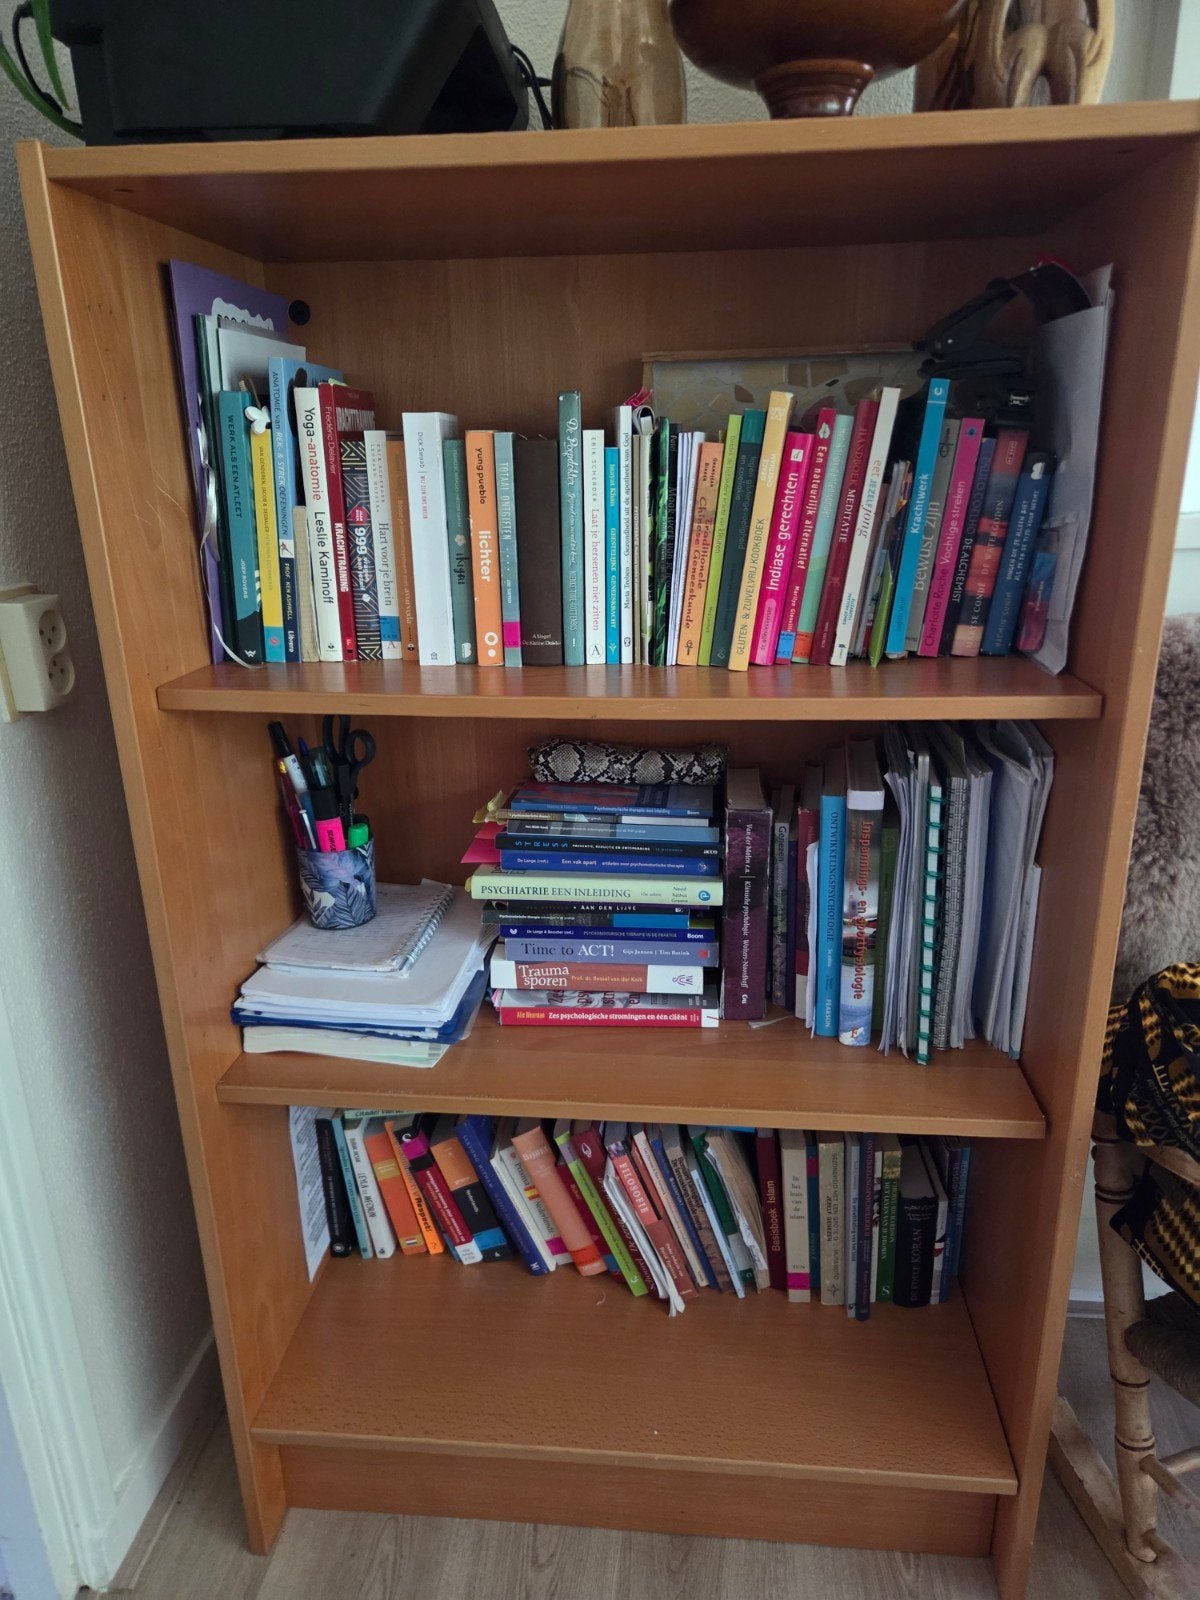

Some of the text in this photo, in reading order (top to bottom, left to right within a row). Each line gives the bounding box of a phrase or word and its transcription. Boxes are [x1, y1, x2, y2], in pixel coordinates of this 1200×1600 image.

[272, 372, 281, 413] ANATOMIE
[276, 431, 285, 450] REK-
[417, 432, 426, 469] Dick Swaab
[562, 418, 578, 486] De Poepdokter
[227, 415, 242, 519] WERK ALS EEN ATLEET
[608, 463, 616, 485] Inayat
[623, 463, 631, 495] apotheek
[838, 427, 867, 543] HANDBOEK MEDITATIE
[277, 461, 289, 535] STREKOEFENINGEN
[304, 407, 334, 604] Yoga-anatomie Leslie Kaminoff
[325, 406, 349, 592] Frédéric Delavier KRACHTTRAINING
[475, 447, 493, 582] yung pueblo lichter
[499, 462, 511, 540] TOTAAL ONTGIFTEN
[623, 496, 630, 505] de
[668, 487, 678, 514] Maak
[797, 445, 828, 570] Een natuurlijk alternatief
[857, 459, 882, 539] eet JEZELF jong
[909, 473, 930, 534] Krachtwerk
[589, 530, 600, 539] je
[591, 508, 600, 528] Laat
[667, 516, 676, 540] werk
[765, 473, 798, 591] Indiase gerechten
[984, 500, 1004, 561] WATERGODIN
[354, 527, 367, 555] 999
[697, 516, 714, 589] Traditionele
[714, 528, 726, 554] kleuren
[914, 501, 940, 590] Bewust zijn
[962, 538, 974, 550] DE
[356, 571, 366, 591] jezelf
[378, 522, 393, 608] Hart voor brein
[453, 553, 470, 585] ikigai
[591, 541, 600, 584] hersenen
[684, 496, 707, 629] Chinese Geneeskunde
[923, 480, 966, 647] Charlotte Roche Vochtige streken
[952, 551, 972, 603] ALCHEMIST
[592, 586, 600, 603] niet
[736, 519, 765, 655] GLUTEN- ZUIVELVRIJ KOOKBOEK
[791, 585, 800, 606] Marilyn
[286, 593, 294, 620] ASHWELL
[404, 588, 413, 625] ayurveda
[592, 605, 600, 631] zitten
[287, 630, 296, 653] Librero
[515, 840, 569, 848] STRESS
[777, 825, 787, 862] Genezen
[857, 819, 874, 896] Inspannings-
[480, 885, 631, 898] PSYCHIATRIE EEN INLEIDING
[743, 880, 752, 905] Klinische
[826, 811, 839, 943] ONTWIKKELINGSPSYCHOLOGIE
[741, 905, 751, 936] psychologie
[858, 900, 867, 914] en
[521, 942, 556, 956] Time
[561, 944, 574, 956] to
[577, 944, 614, 957] ACT!
[741, 939, 750, 988] Wolters-Noordhoff
[851, 916, 869, 1000] sportfysiologie
[518, 964, 569, 977] Trauma
[523, 975, 568, 989] sporen
[548, 1012, 559, 1020] Zes
[560, 1012, 608, 1022] psychologische
[609, 1012, 646, 1022] stromingen
[656, 1013, 668, 1021] één
[669, 1013, 688, 1021] cliënt
[824, 999, 832, 1028] PEARSON
[357, 1172, 368, 1189] LEYLA
[514, 1162, 532, 1186] Prisma
[618, 1161, 650, 1214] FILOSOFIE
[831, 1152, 840, 1189] GEZONDHEID
[414, 1197, 432, 1232] Respect!
[766, 1180, 781, 1252] Basisboek Islam
[911, 1227, 923, 1264] KORAN
